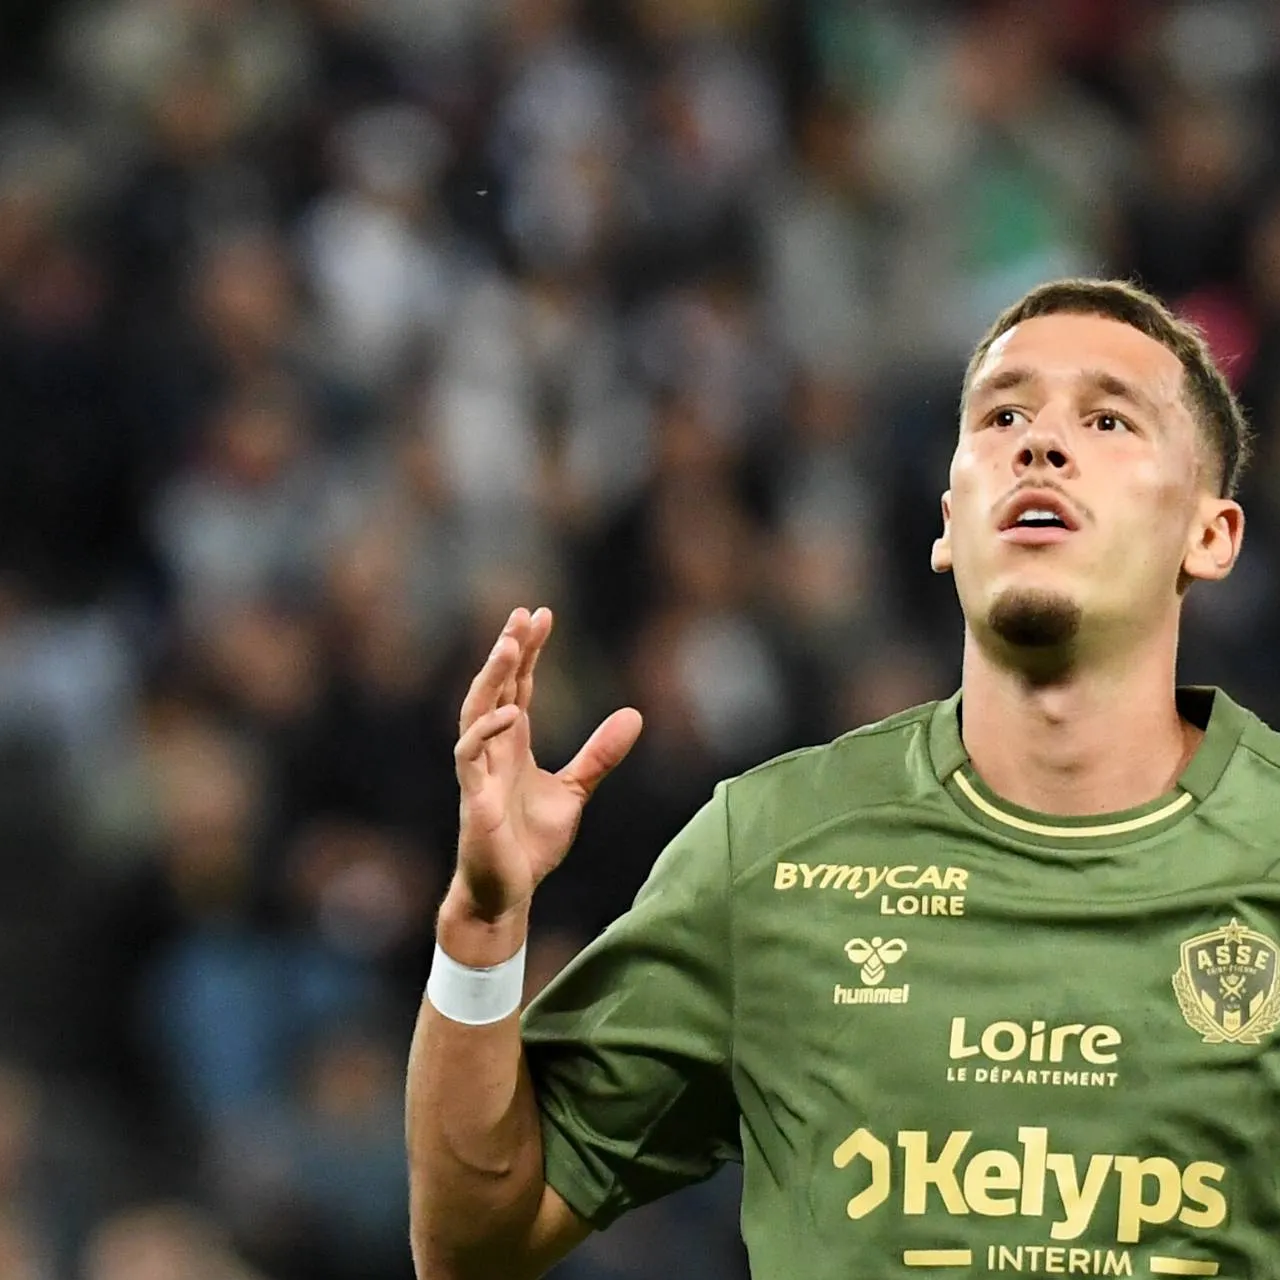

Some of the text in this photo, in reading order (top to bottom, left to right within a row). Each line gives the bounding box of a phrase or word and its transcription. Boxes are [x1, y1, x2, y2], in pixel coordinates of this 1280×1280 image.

[880, 895, 966, 916] LOIRE
[1197, 945, 1270, 970] ASSE
[833, 983, 910, 1004] hummel
[949, 1017, 1122, 1065] Loire
[947, 1067, 1119, 1087] LE DÉPARTEMENT
[897, 1126, 1227, 1243] Kelyps
[987, 1245, 1133, 1276] INTERIM
